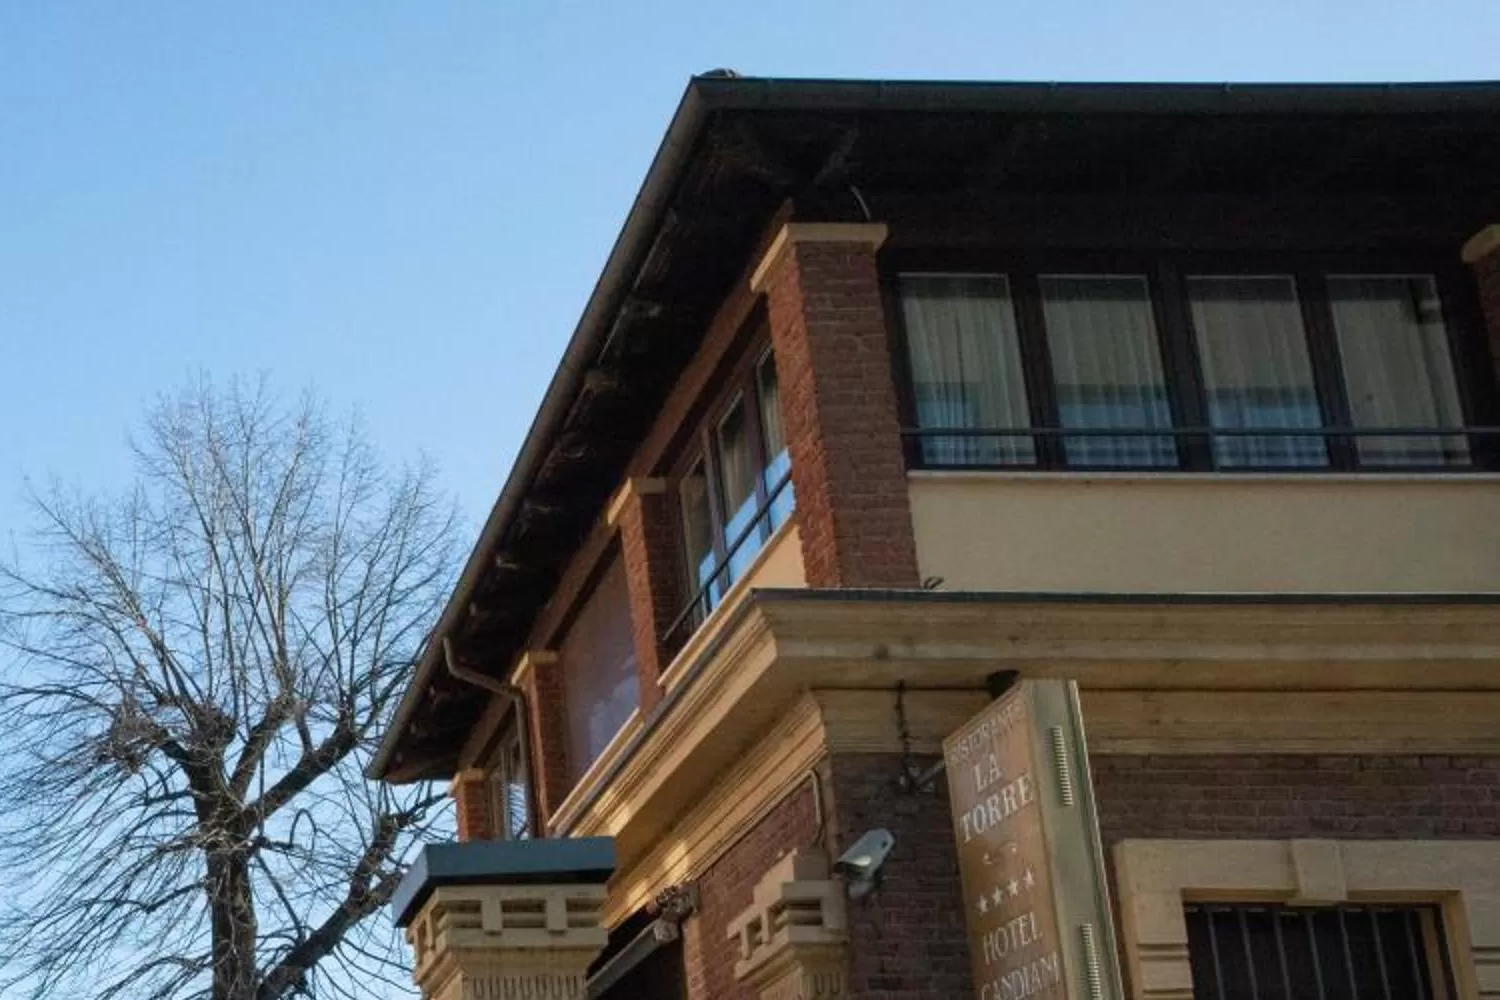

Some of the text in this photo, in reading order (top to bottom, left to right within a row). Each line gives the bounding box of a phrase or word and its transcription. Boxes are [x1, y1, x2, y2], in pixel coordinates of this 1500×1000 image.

[973, 753, 1002, 793] LA
[960, 775, 1034, 843] TORRE
[983, 911, 1044, 966] HOTEL
